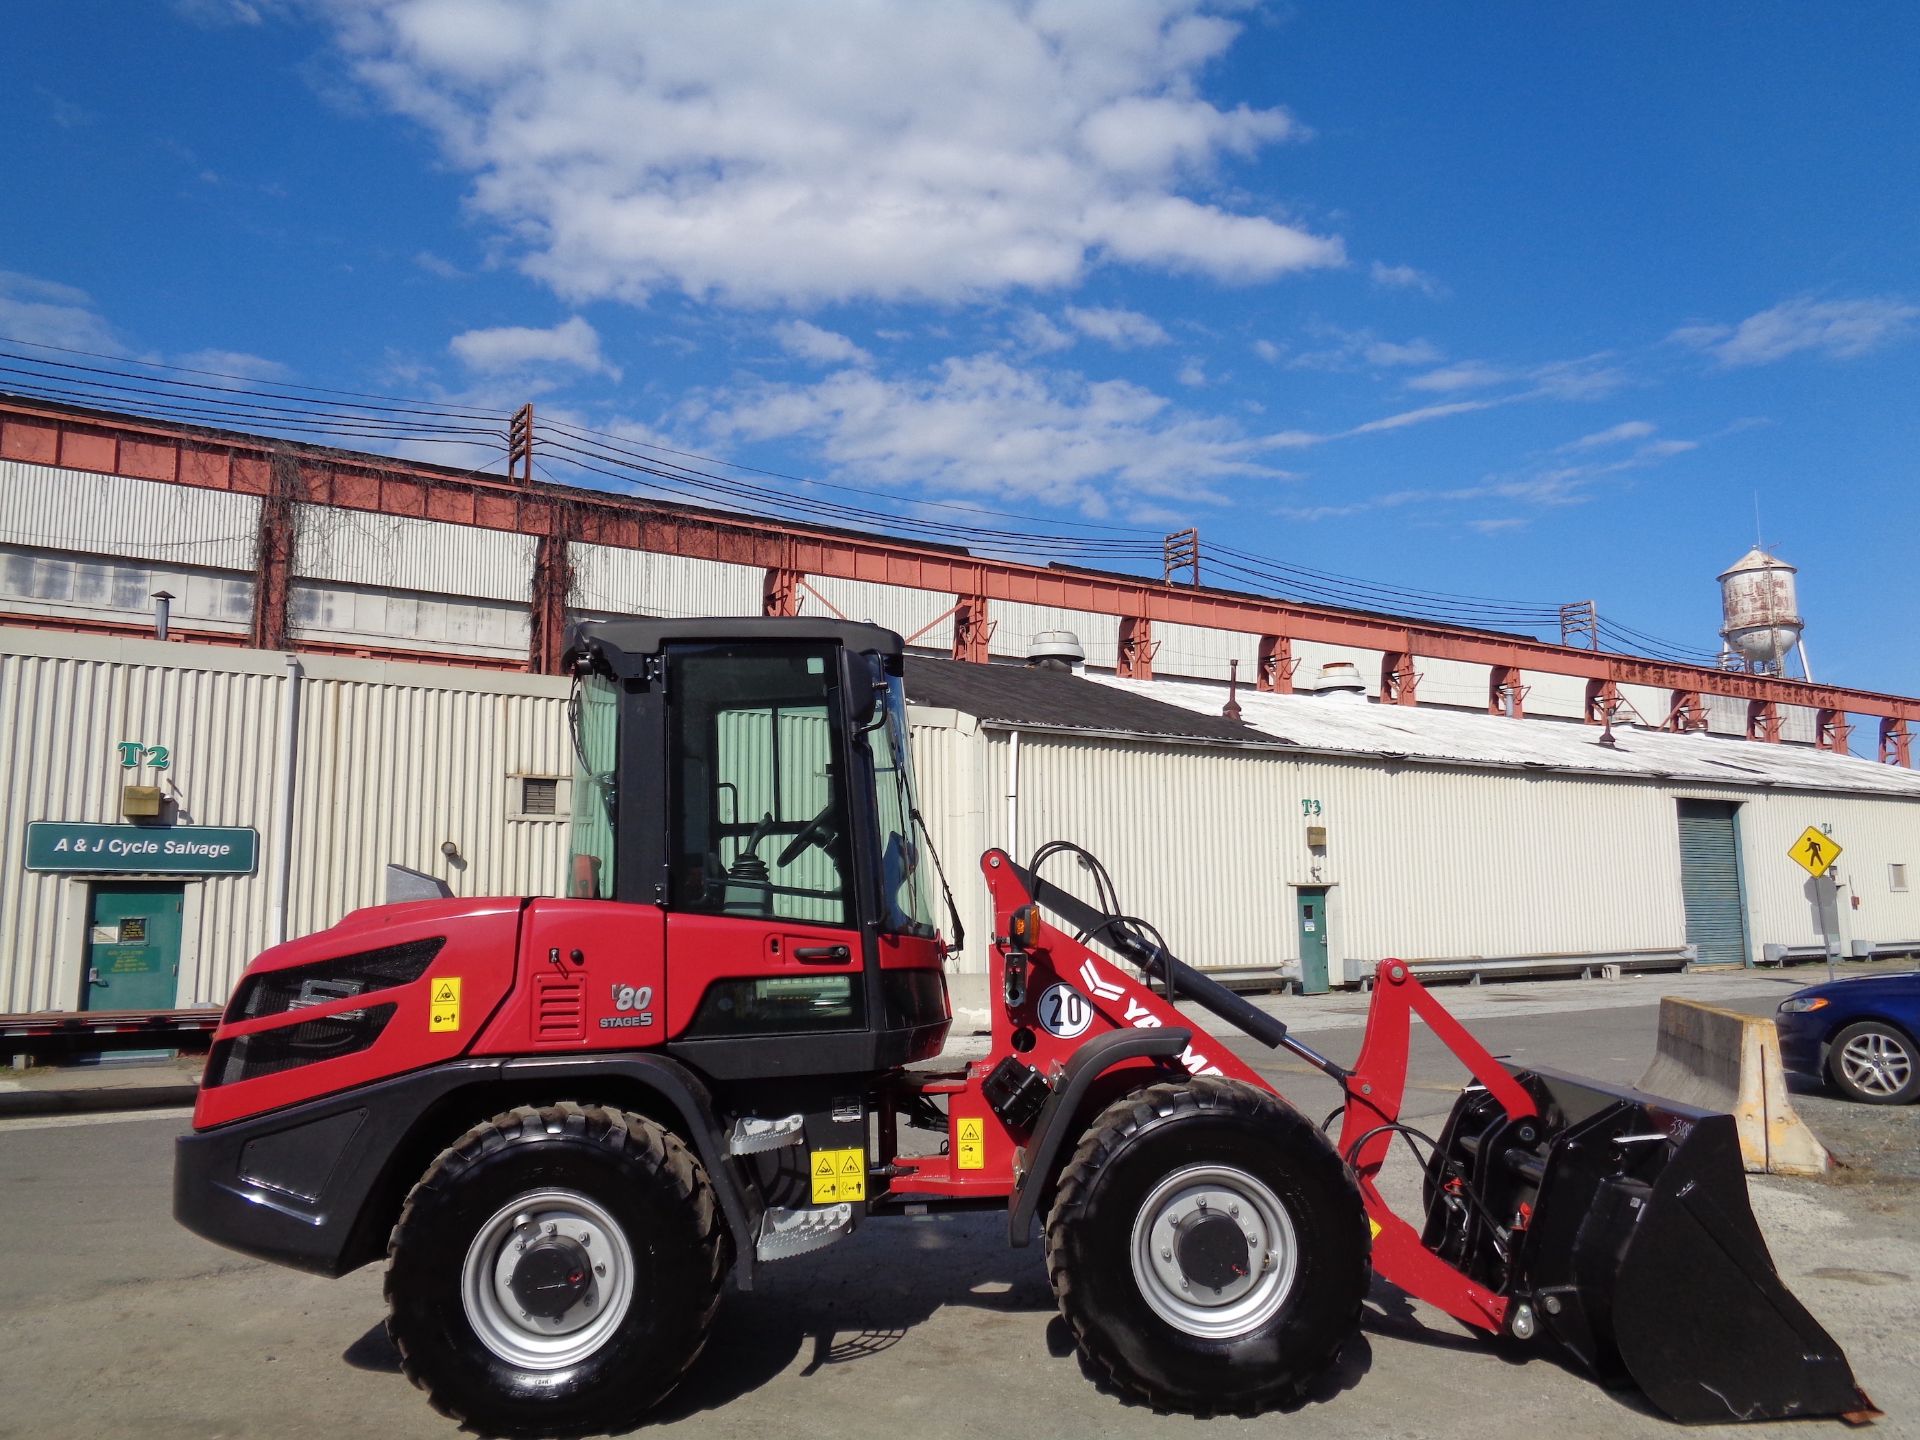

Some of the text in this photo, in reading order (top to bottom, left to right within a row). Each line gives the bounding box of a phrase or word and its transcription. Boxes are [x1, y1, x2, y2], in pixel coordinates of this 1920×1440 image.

[118, 741, 169, 769] T2
[1301, 799, 1321, 815] T3
[54, 838, 230, 858] A & J Cycle Salvage
[1049, 993, 1082, 1027] 20
